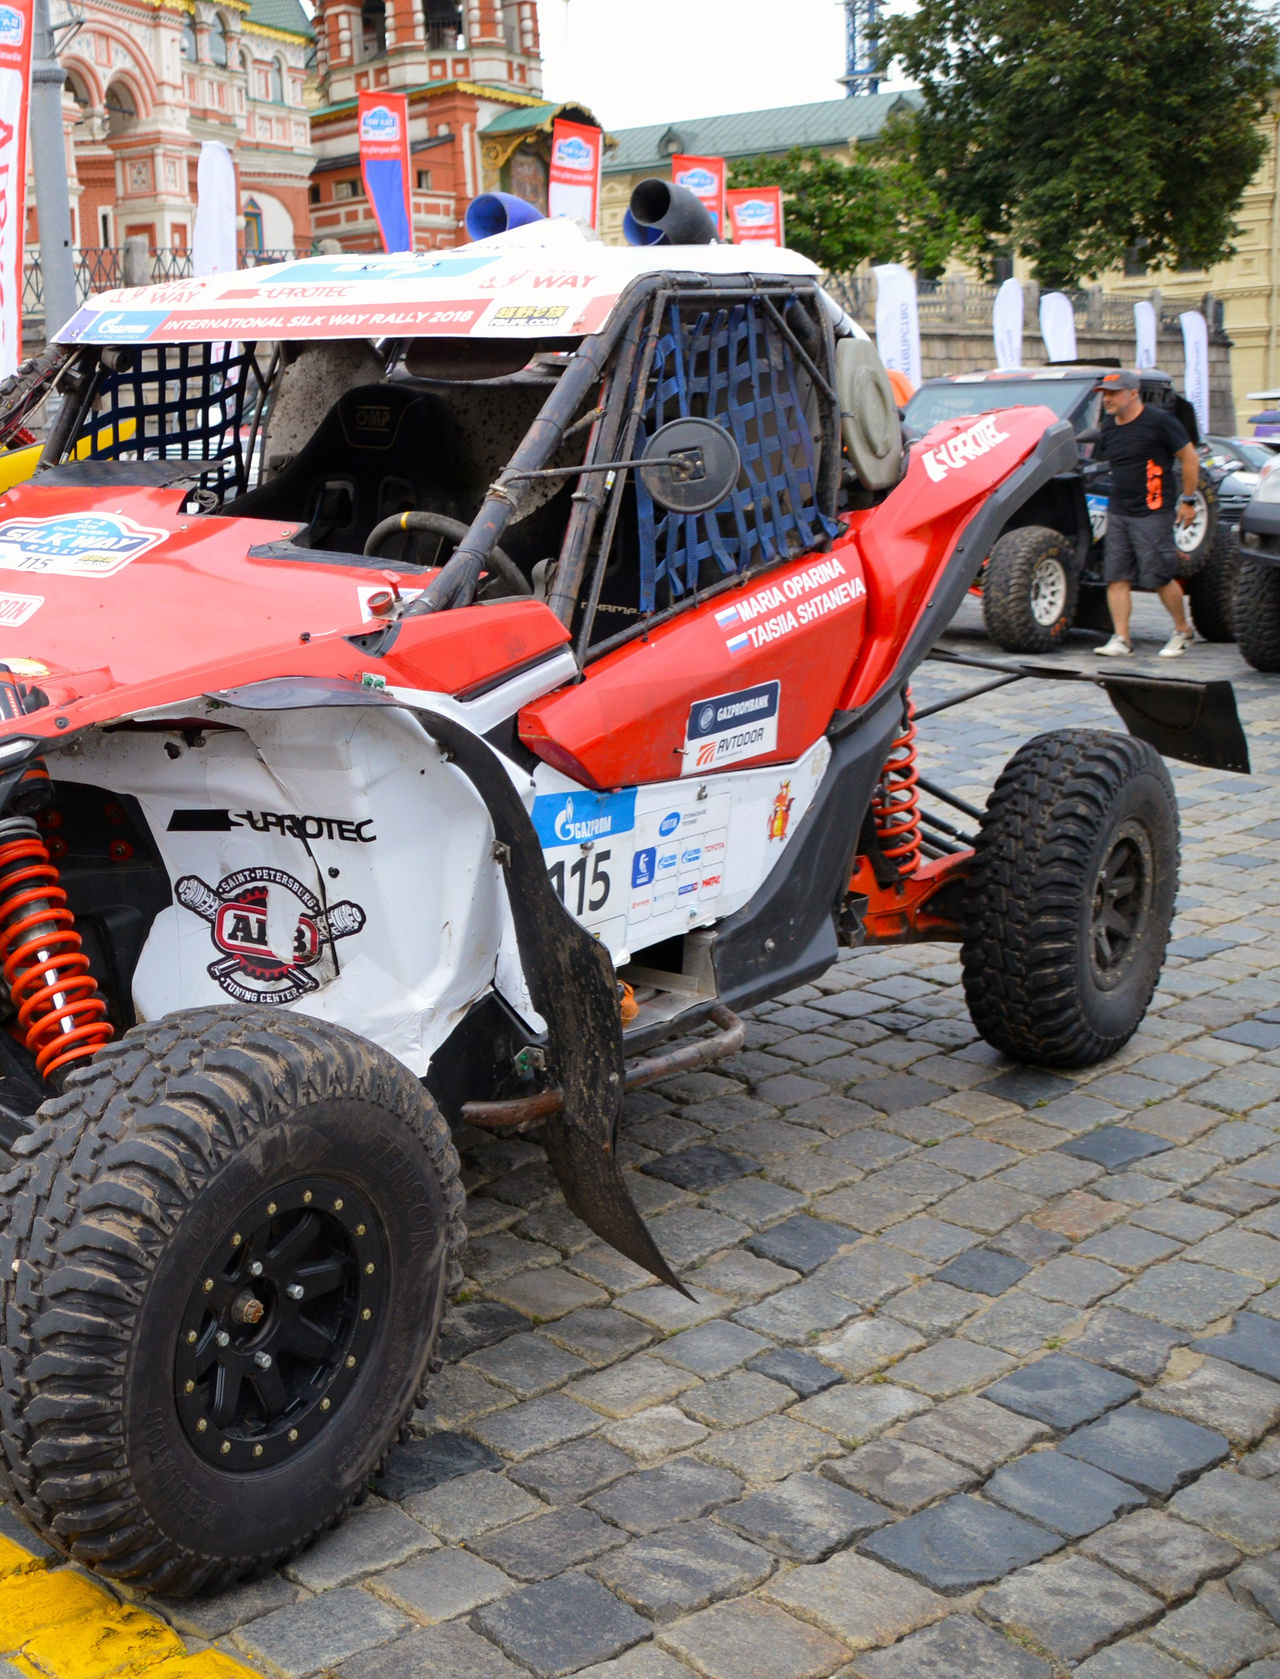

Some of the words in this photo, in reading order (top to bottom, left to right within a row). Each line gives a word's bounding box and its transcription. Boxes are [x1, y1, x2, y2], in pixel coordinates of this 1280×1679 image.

[532, 275, 599, 289] WAY
[149, 291, 202, 304] WAY
[163, 316, 285, 331] INTERNATIONAL
[287, 315, 328, 328] SILK
[328, 313, 371, 326] WAY
[368, 311, 431, 325] RALLY
[428, 310, 474, 323] 2018
[355, 410, 390, 427] OMP
[25, 544, 83, 556] RALLY
[68, 536, 143, 550] WAY
[18, 557, 54, 570] 115
[736, 586, 787, 622] MARIA
[783, 558, 846, 599] OPARINA
[747, 610, 799, 648] TAISIIA
[796, 577, 867, 625] SHTANEVA
[716, 694, 770, 722] GAZPROMBANK
[717, 727, 764, 754] AVTODOR
[228, 809, 377, 843] SUPROTEC
[575, 815, 612, 840] GAZPROM
[548, 849, 611, 917] 115
[223, 976, 257, 1002] TUNING
[259, 988, 301, 1003] CENTER
[361, 1132, 436, 1258] TENSOR
[143, 1406, 225, 1532] REGULATOR
